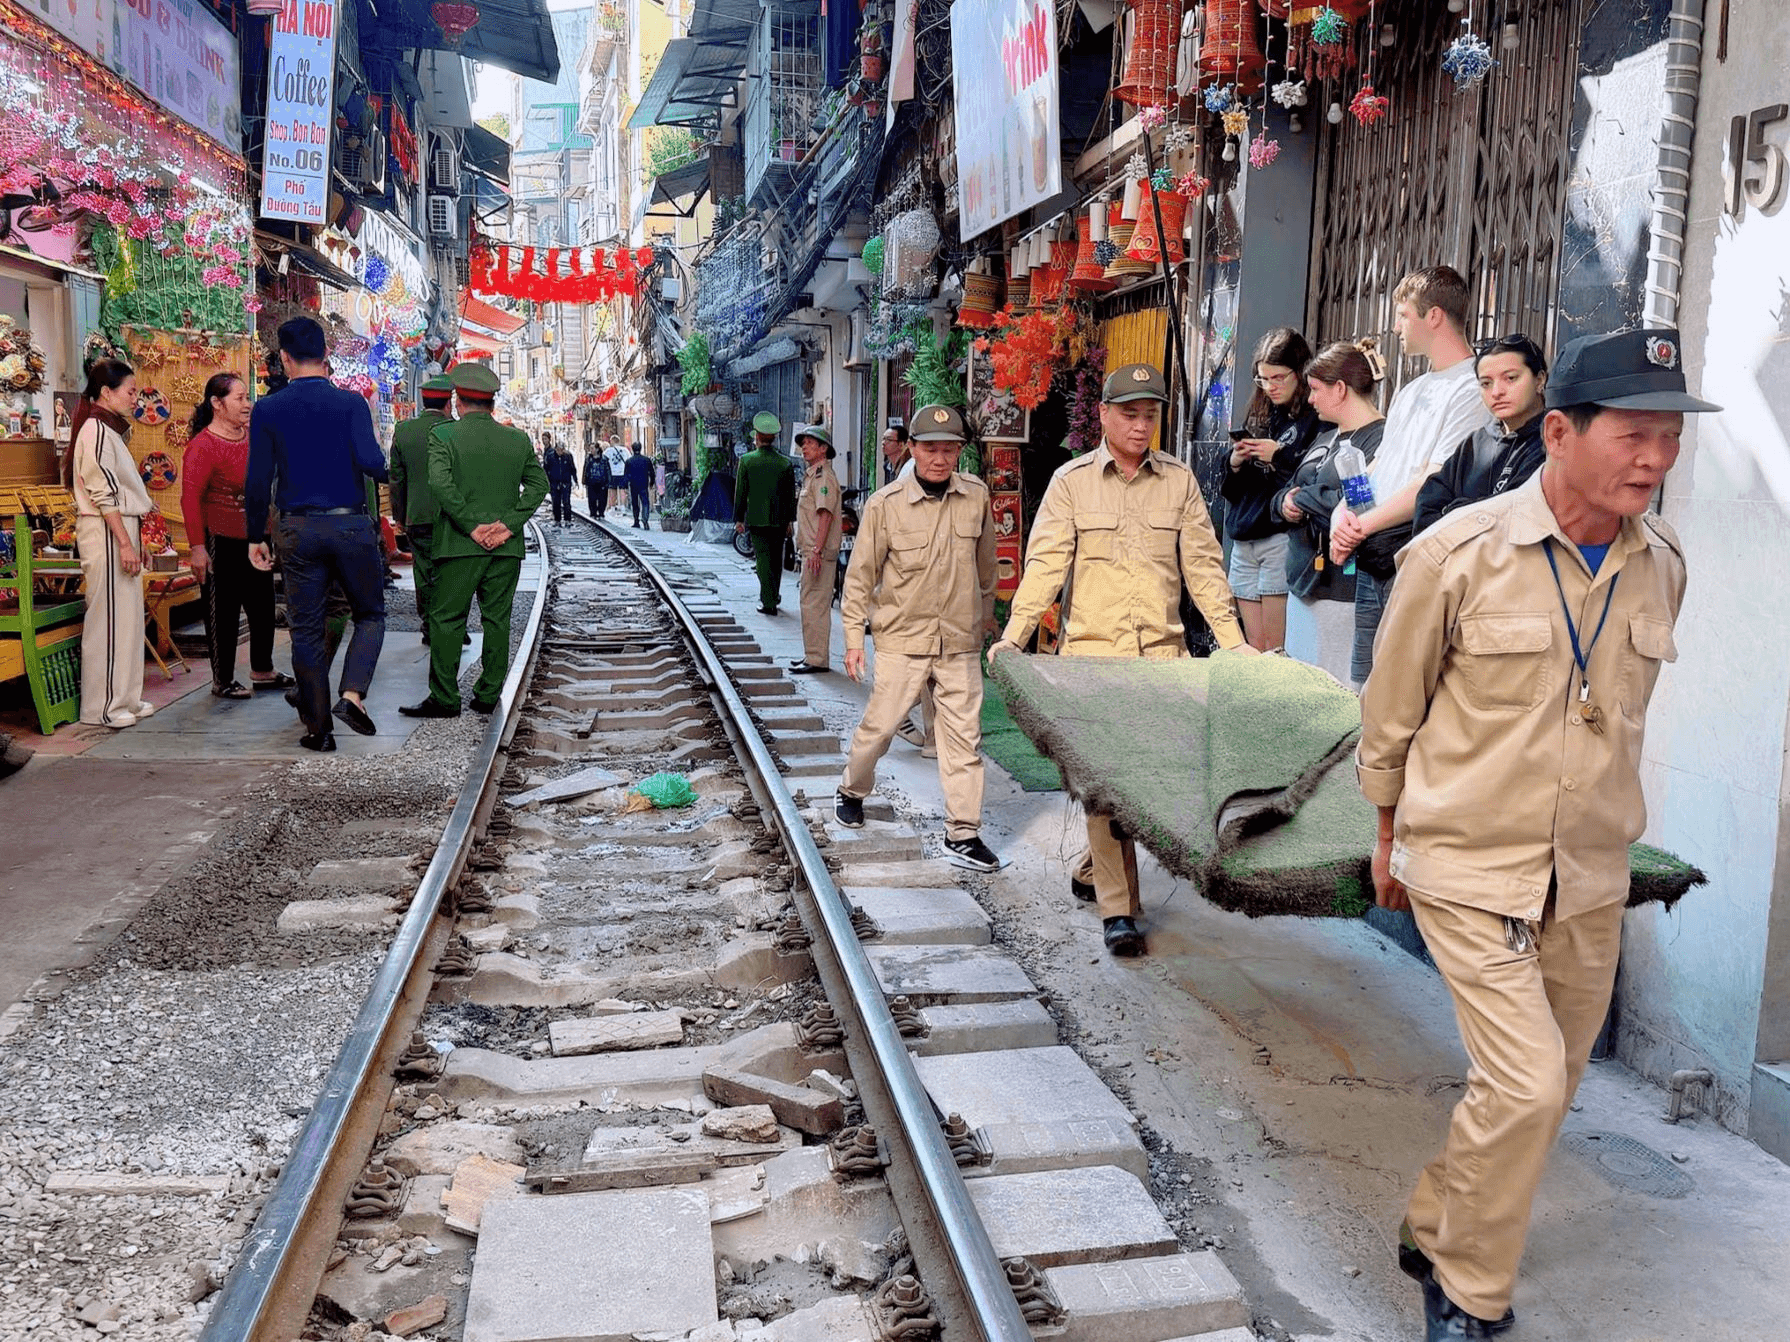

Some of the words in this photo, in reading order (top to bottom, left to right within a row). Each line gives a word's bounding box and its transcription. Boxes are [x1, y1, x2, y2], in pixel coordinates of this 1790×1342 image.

[174, 15, 225, 85] DRINK
[273, 55, 327, 108] Coffee
[293, 119, 308, 143] Bon
[311, 121, 326, 144] Bon
[1724, 104, 1788, 216] 15
